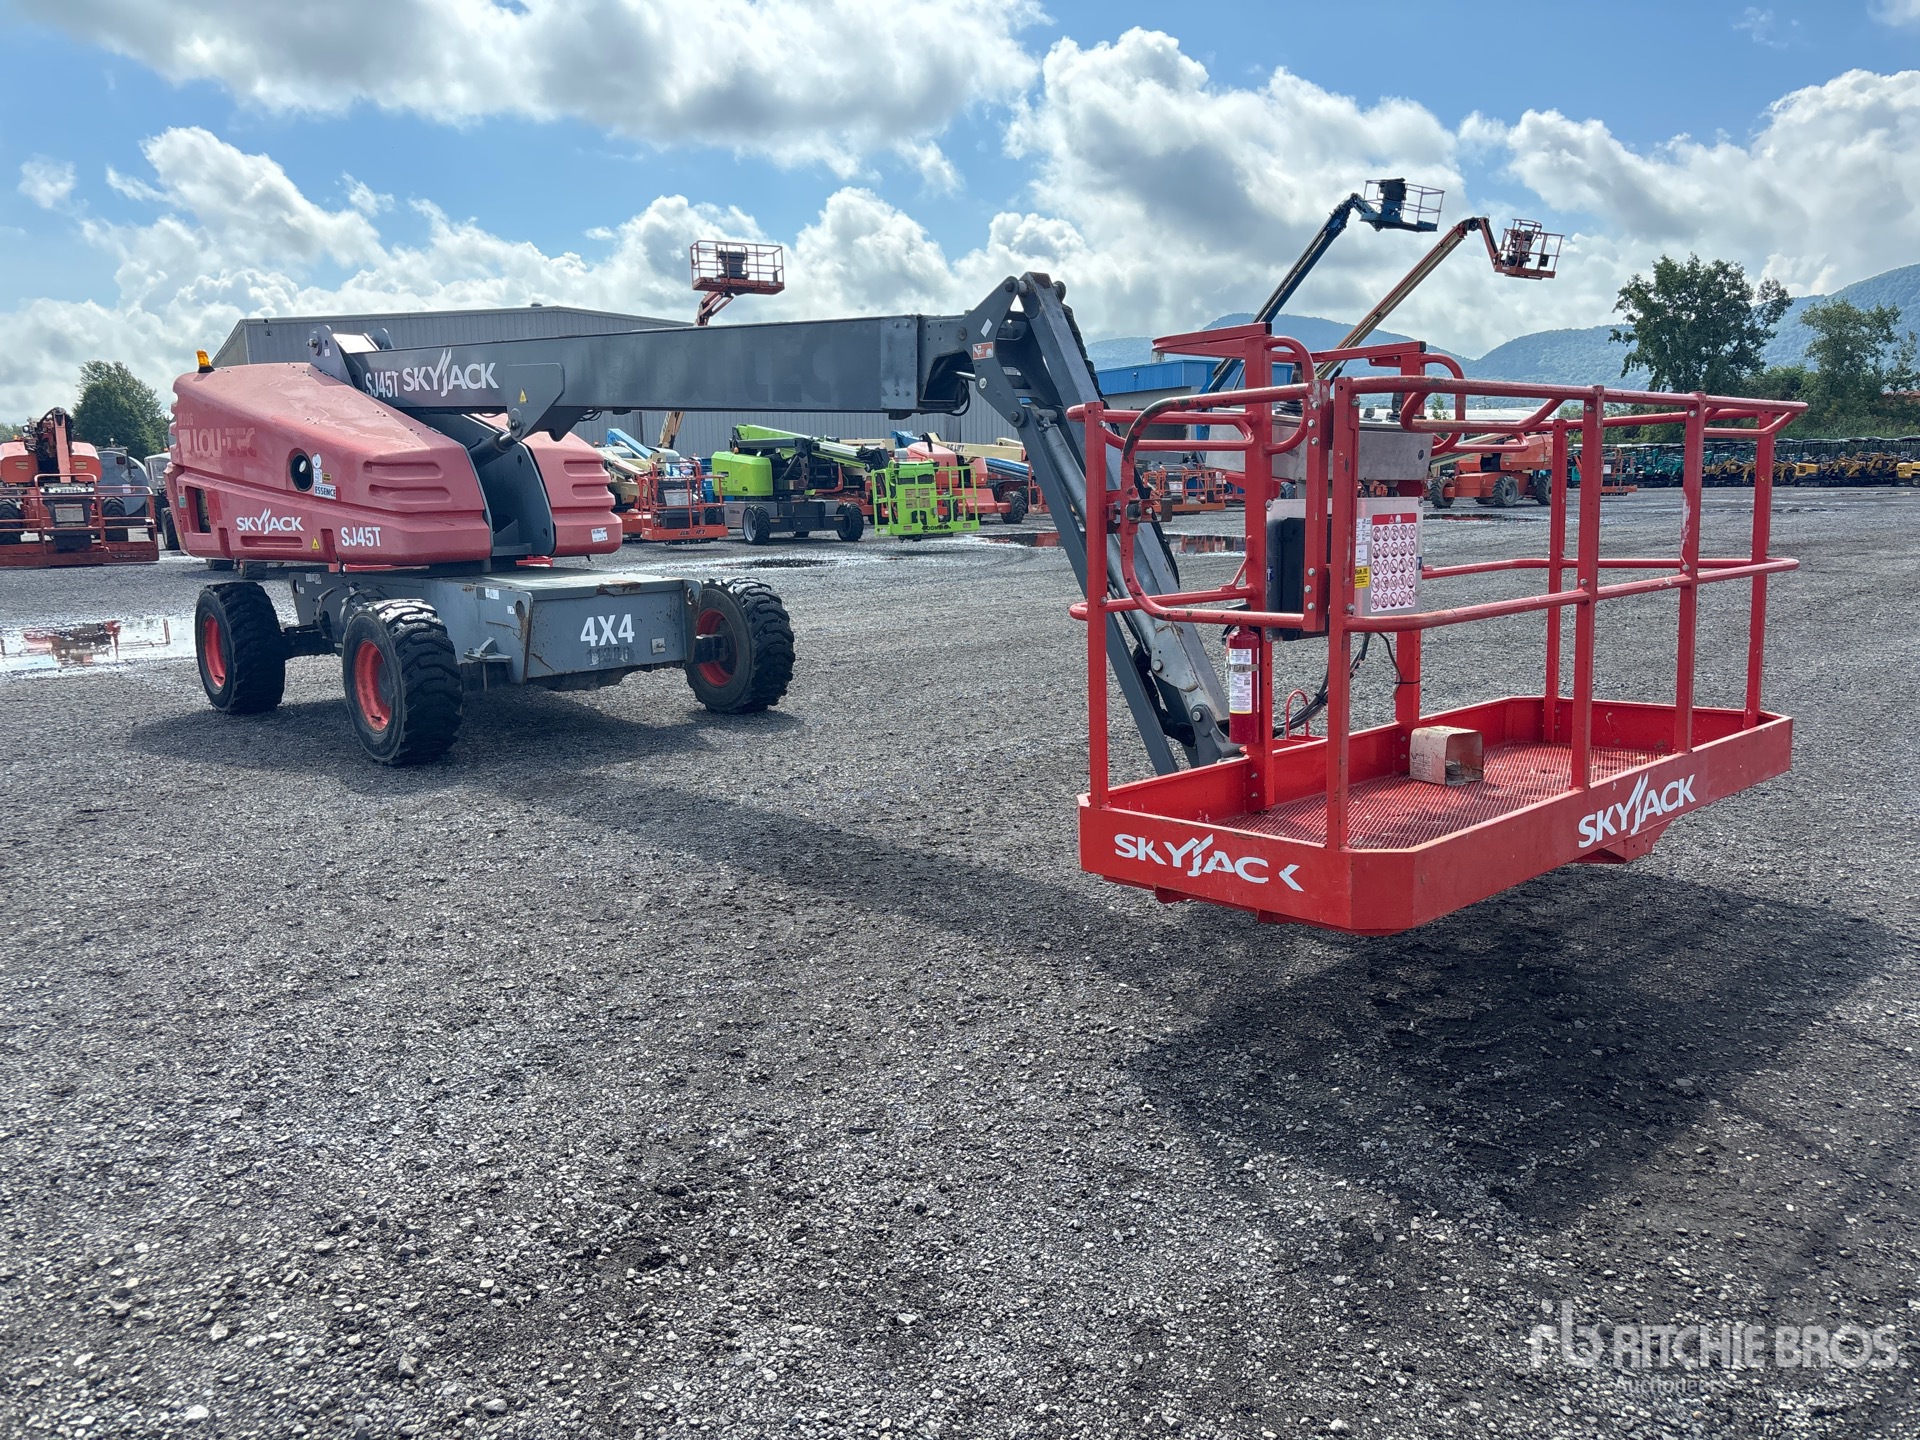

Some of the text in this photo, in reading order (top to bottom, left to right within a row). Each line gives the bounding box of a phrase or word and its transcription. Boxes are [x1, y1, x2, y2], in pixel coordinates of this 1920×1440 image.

[365, 348, 499, 398] SJ45T SKYJACK
[314, 484, 336, 498] ESSENCE
[236, 508, 304, 535] SKYJACK
[340, 526, 381, 547] SJ45T
[580, 613, 635, 647] 4X4
[1578, 772, 1696, 848] SKYJACK
[1114, 833, 1304, 892] SKYJACK
